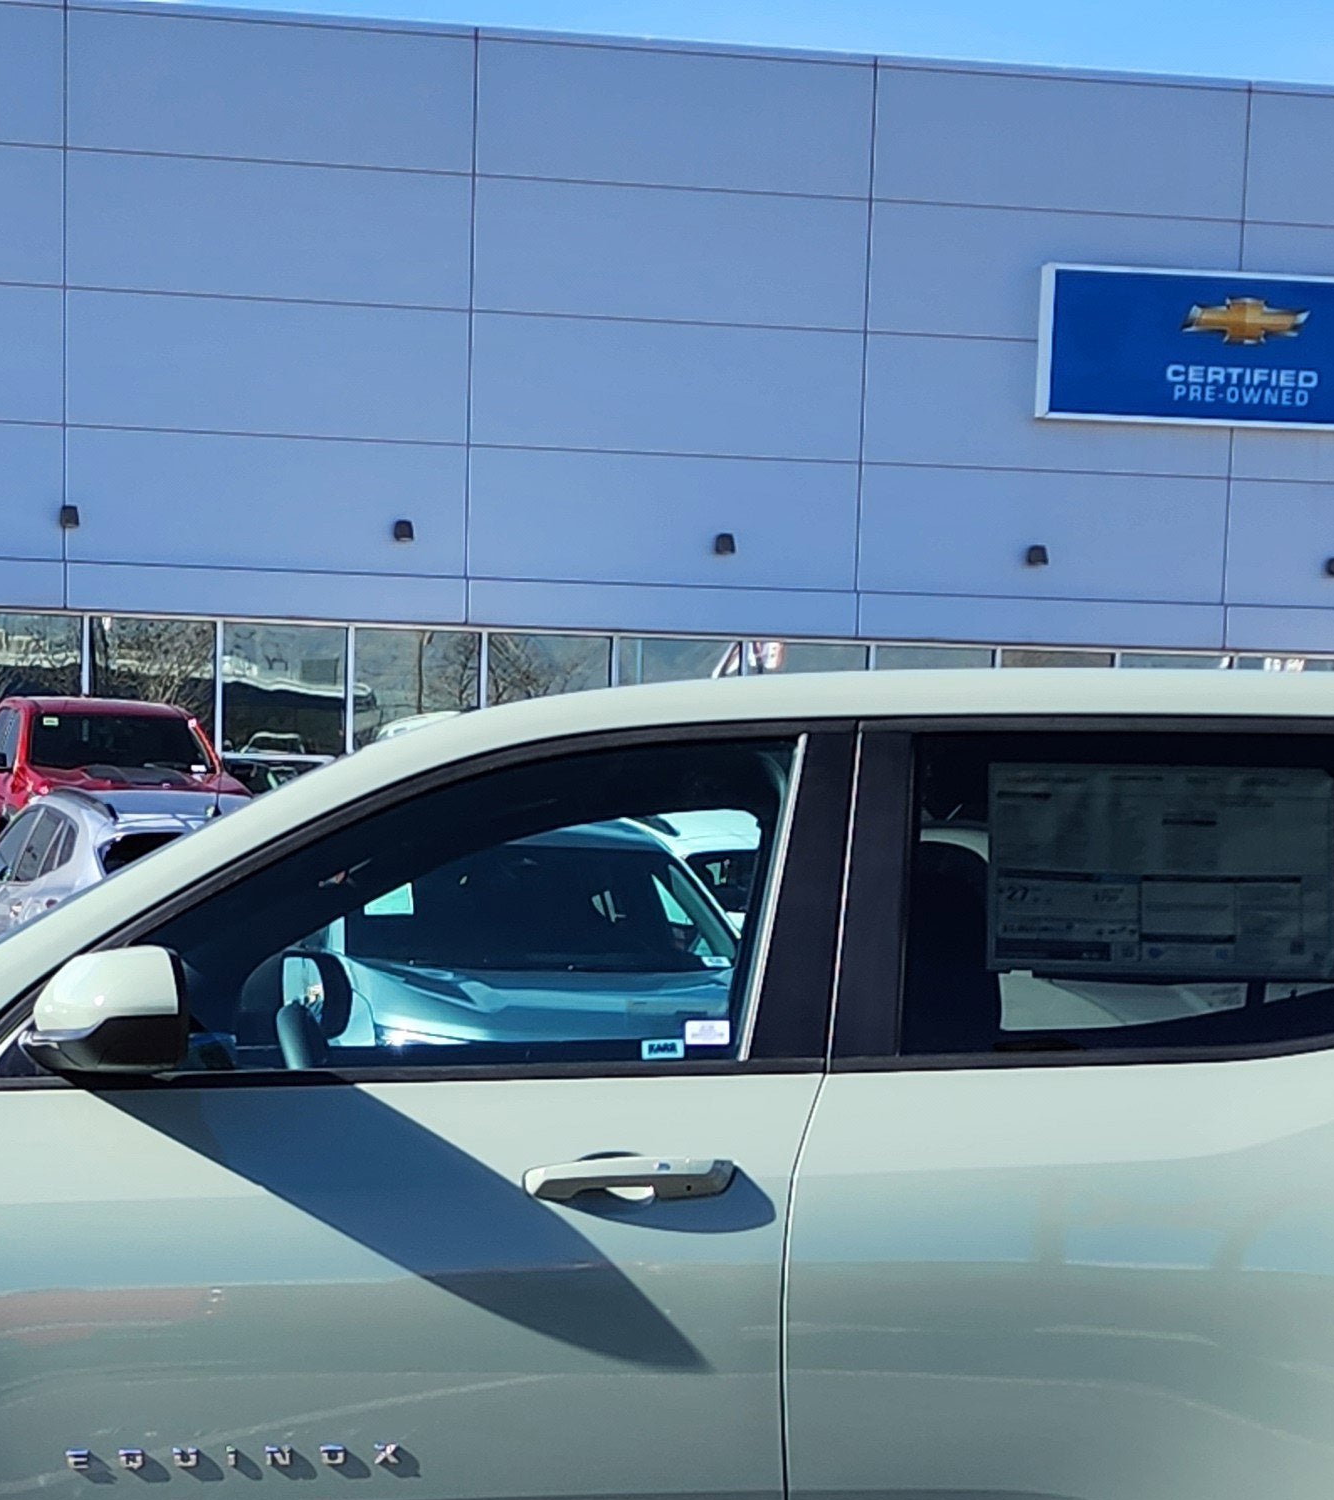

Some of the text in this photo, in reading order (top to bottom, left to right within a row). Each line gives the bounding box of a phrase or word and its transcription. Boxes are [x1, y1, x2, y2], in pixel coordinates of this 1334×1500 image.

[1167, 364, 1318, 388] CERTIFIED
[1173, 384, 1309, 406] PRE-OWNED
[66, 1442, 401, 1470] EQUINOX
